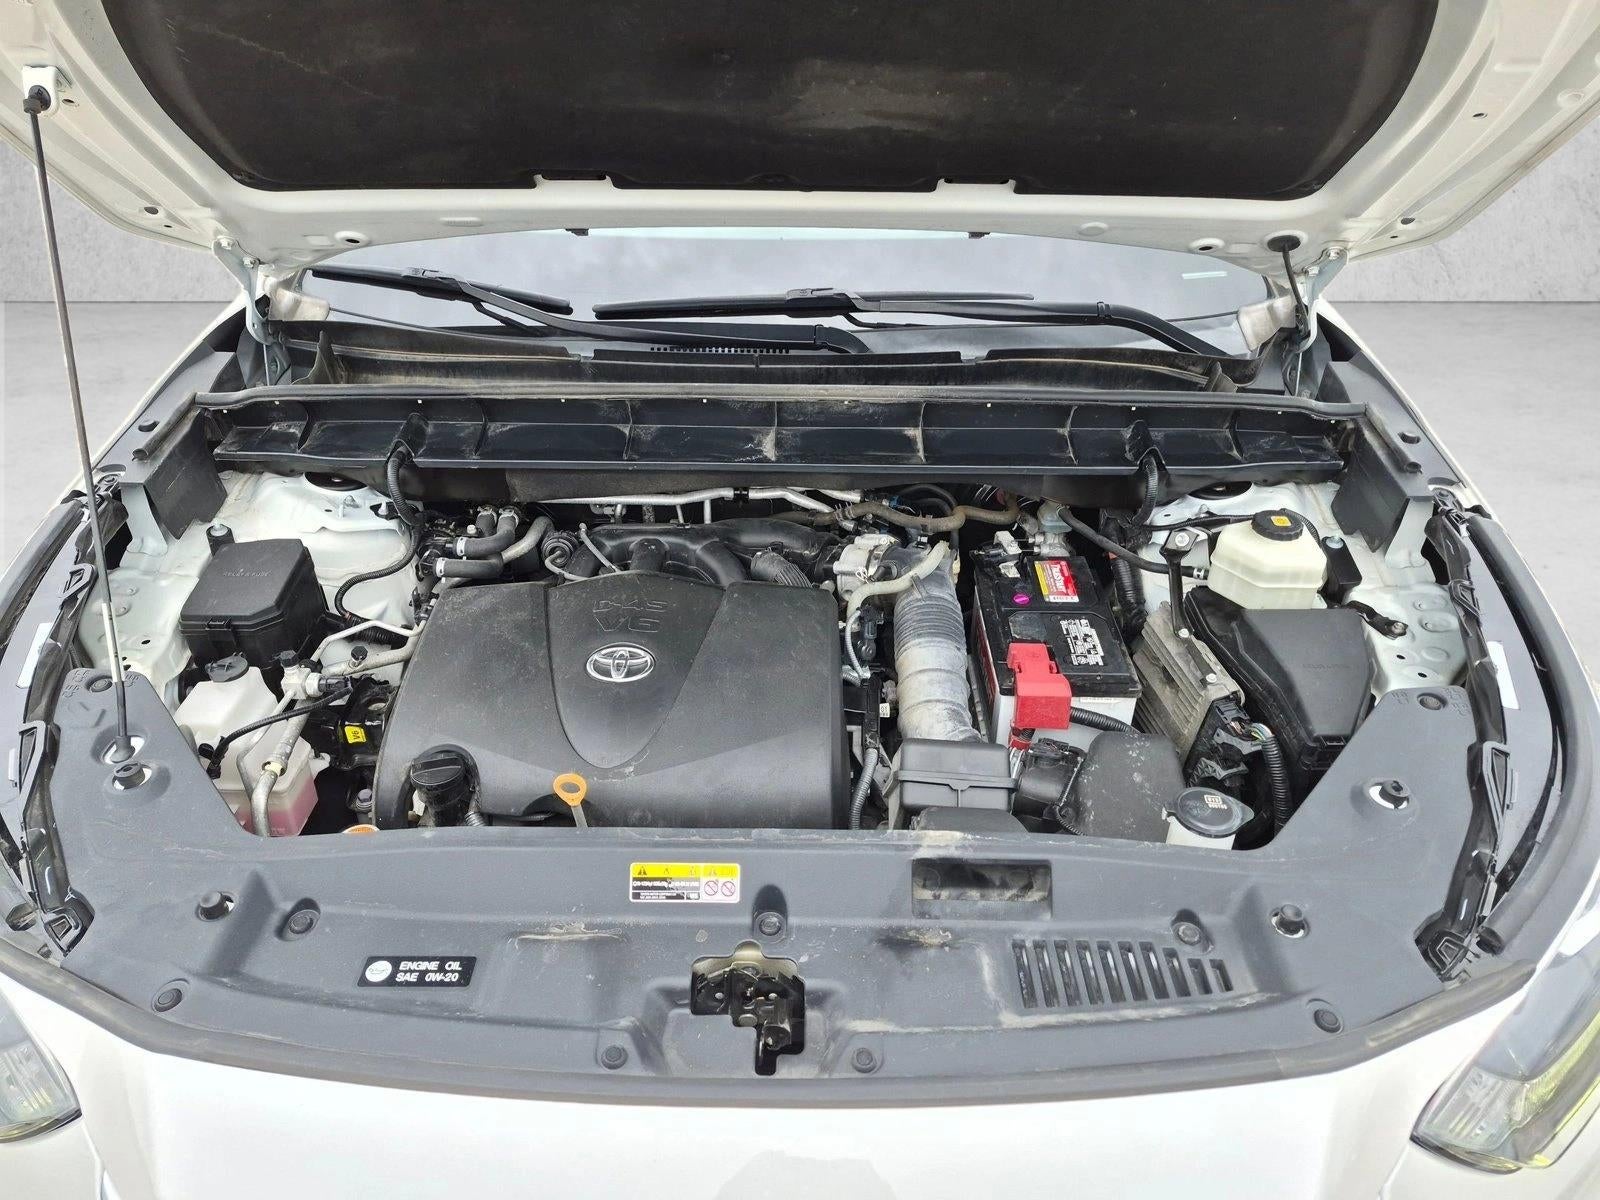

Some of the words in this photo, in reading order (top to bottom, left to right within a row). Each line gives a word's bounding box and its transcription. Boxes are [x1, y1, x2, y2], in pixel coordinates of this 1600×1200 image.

[593, 614, 660, 633] V6
[398, 960, 440, 971] ENGINE
[445, 961, 463, 971] OIL
[395, 972, 420, 982] SAE
[424, 972, 459, 982] 0W-20
